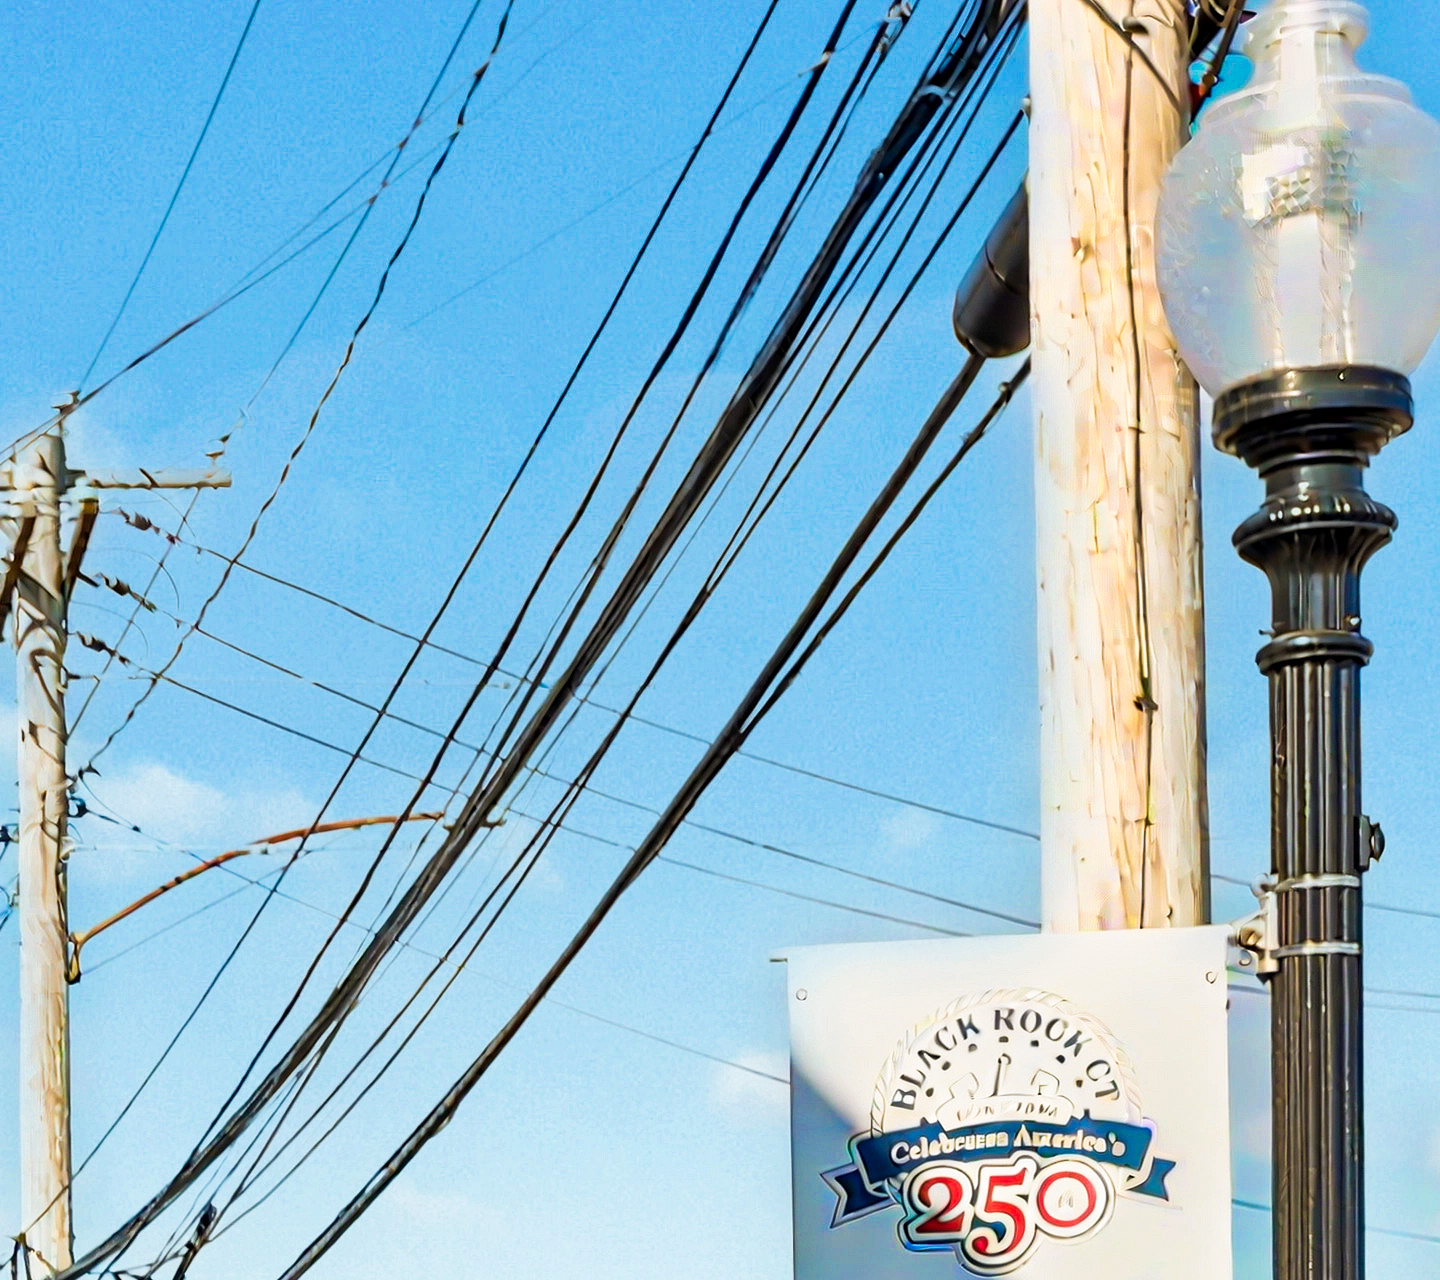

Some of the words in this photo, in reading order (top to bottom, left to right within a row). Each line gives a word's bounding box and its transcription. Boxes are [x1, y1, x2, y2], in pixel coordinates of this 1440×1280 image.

[890, 1014, 980, 1110] BLACK
[1085, 1059, 1122, 1101] CT
[914, 1167, 1098, 1257] 250
